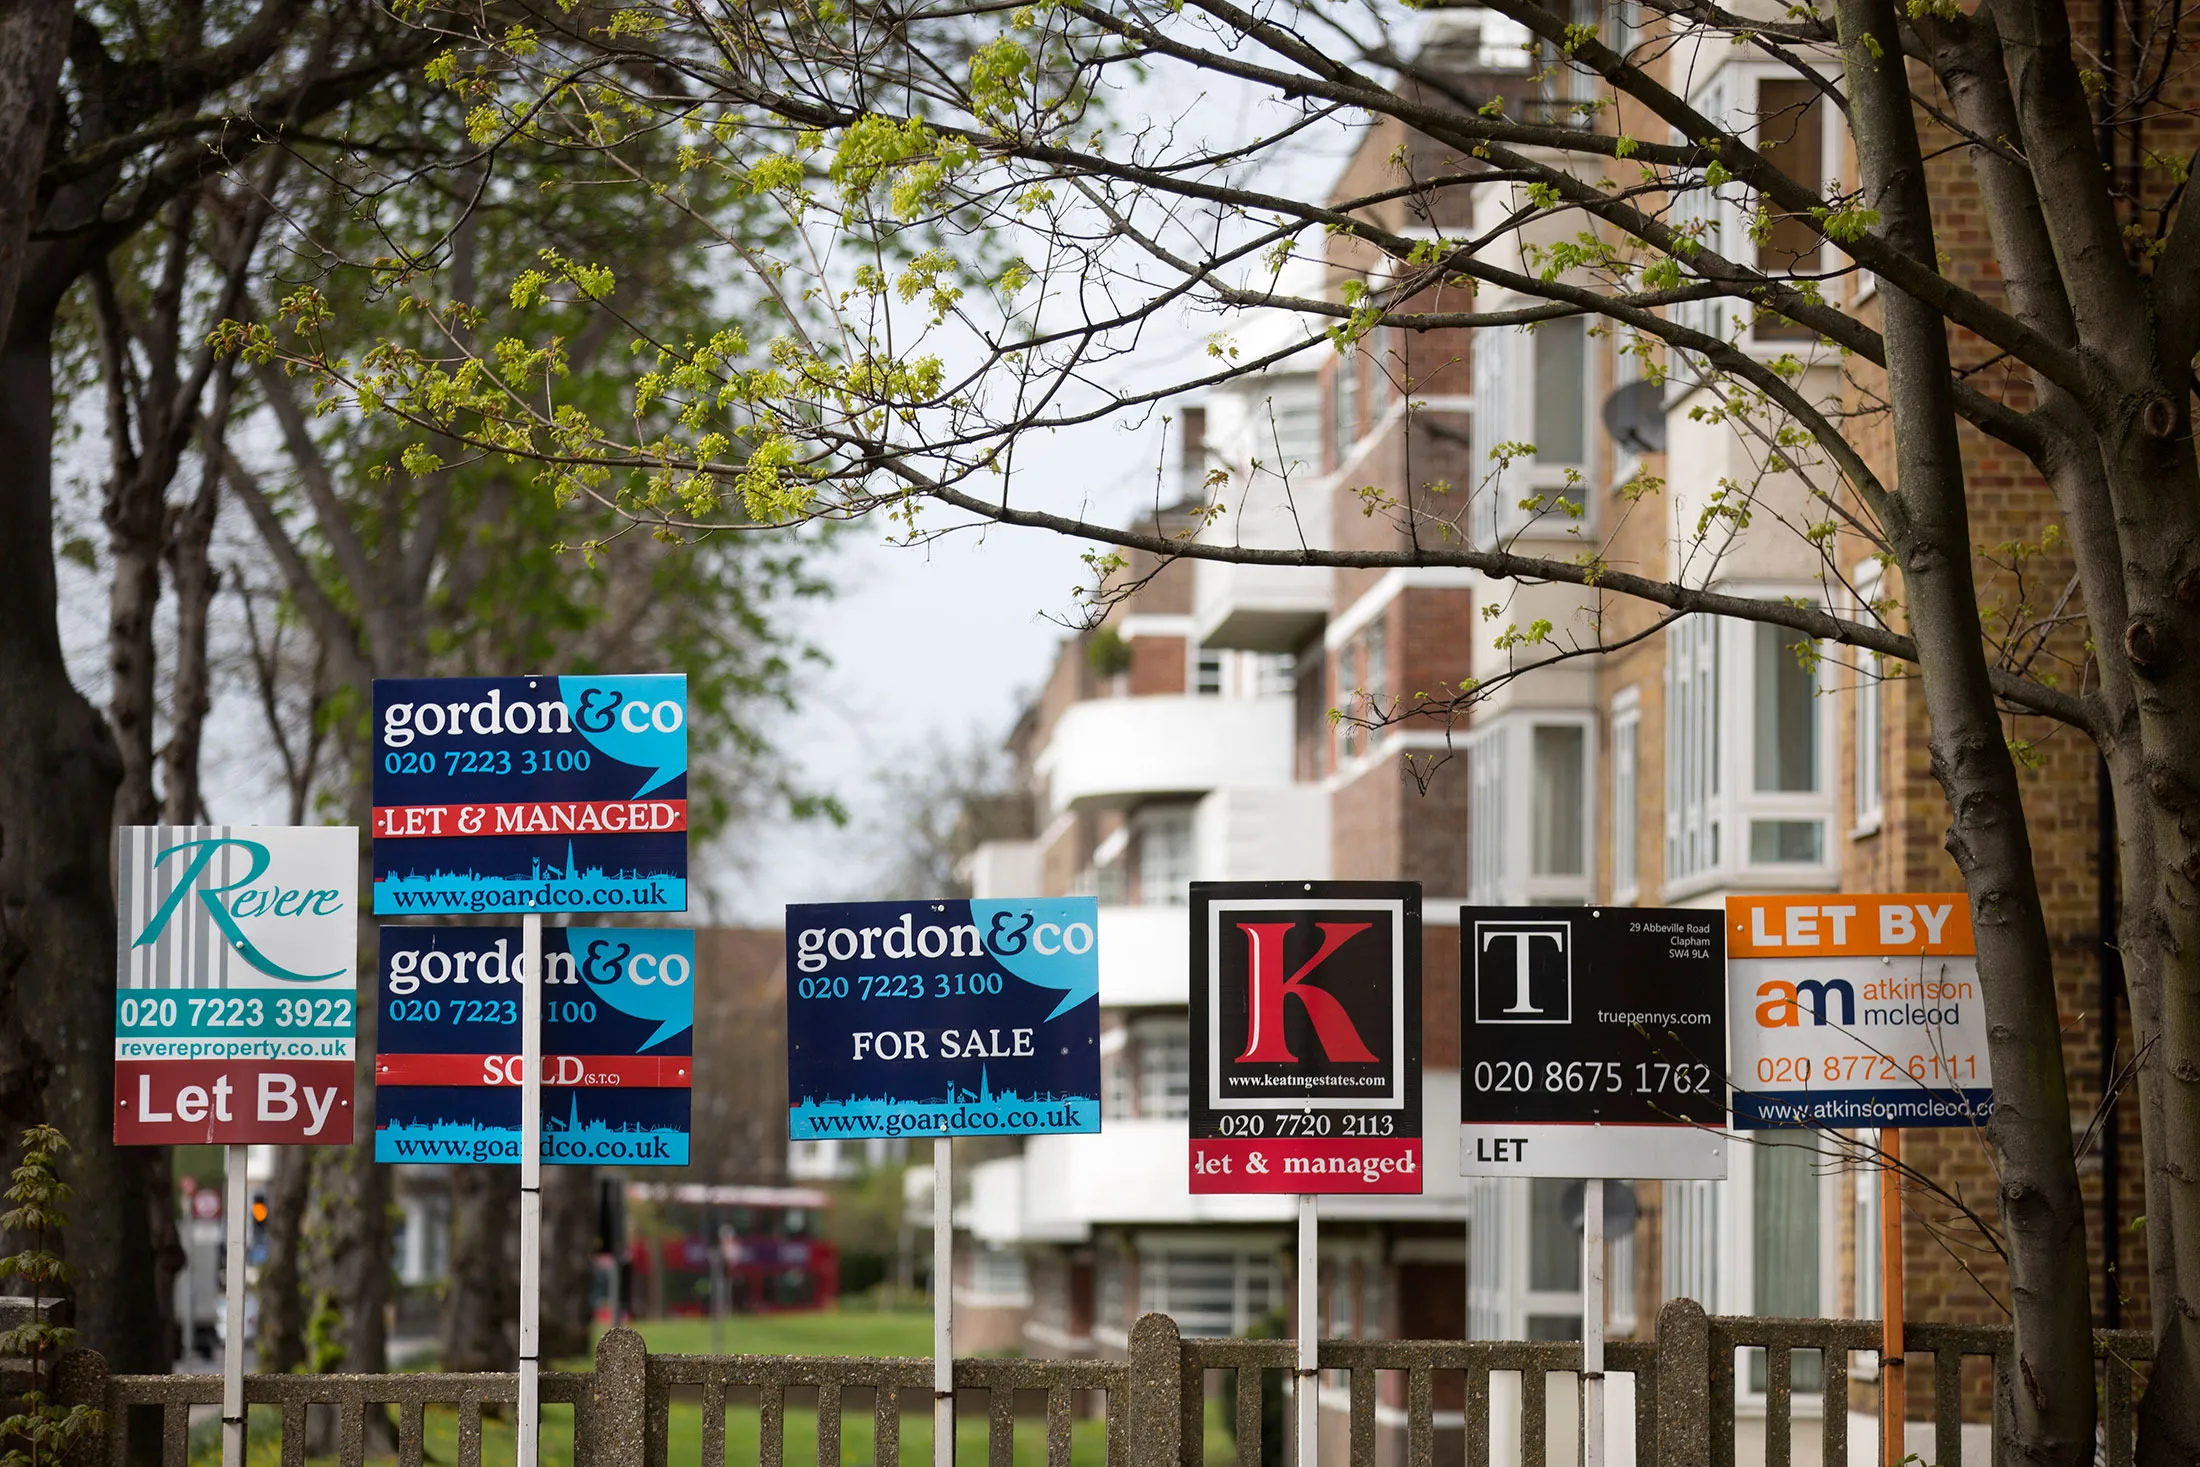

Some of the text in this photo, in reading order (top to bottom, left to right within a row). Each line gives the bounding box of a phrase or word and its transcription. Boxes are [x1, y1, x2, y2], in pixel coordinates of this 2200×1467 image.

[383, 688, 683, 748] gordon&co
[385, 750, 591, 776] 020 7223 3100
[384, 803, 674, 836] LET & MANAGED
[131, 838, 347, 982] Revere
[393, 882, 667, 912] www.goandco.co.uk
[1629, 923, 1710, 934] 29 Abbeville Road
[1751, 904, 1953, 947] LET BY
[796, 911, 1094, 973] gordon&co
[1669, 949, 1709, 959] SW4 9LA
[1670, 936, 1711, 948] Clapham
[798, 972, 1003, 1001] 020 7223 3100
[1483, 931, 1563, 1013] T
[1234, 922, 1380, 1063] K
[1863, 977, 1972, 1000] atkinson
[121, 998, 351, 1027] 020 7223 3922
[389, 999, 597, 1025] 020 7223 100
[1755, 978, 1855, 1029] am
[1864, 1003, 1959, 1026] mcleod
[1598, 1010, 1711, 1028] truepennys.com
[121, 1039, 346, 1060] revereproperty.co.uk
[852, 1028, 1035, 1061] FOR SALE
[1474, 1061, 1710, 1094] 020 8675 1762
[1757, 1054, 1976, 1083] 020 8772 6111
[139, 1072, 338, 1136] Let By
[808, 1103, 1082, 1137] www.goandco.co.uk
[1219, 1114, 1394, 1137] 020 7720 2113
[395, 1136, 670, 1162] www.goadco.co.uk
[1477, 1138, 1528, 1162] LET
[1197, 1150, 1414, 1183] let & managed
